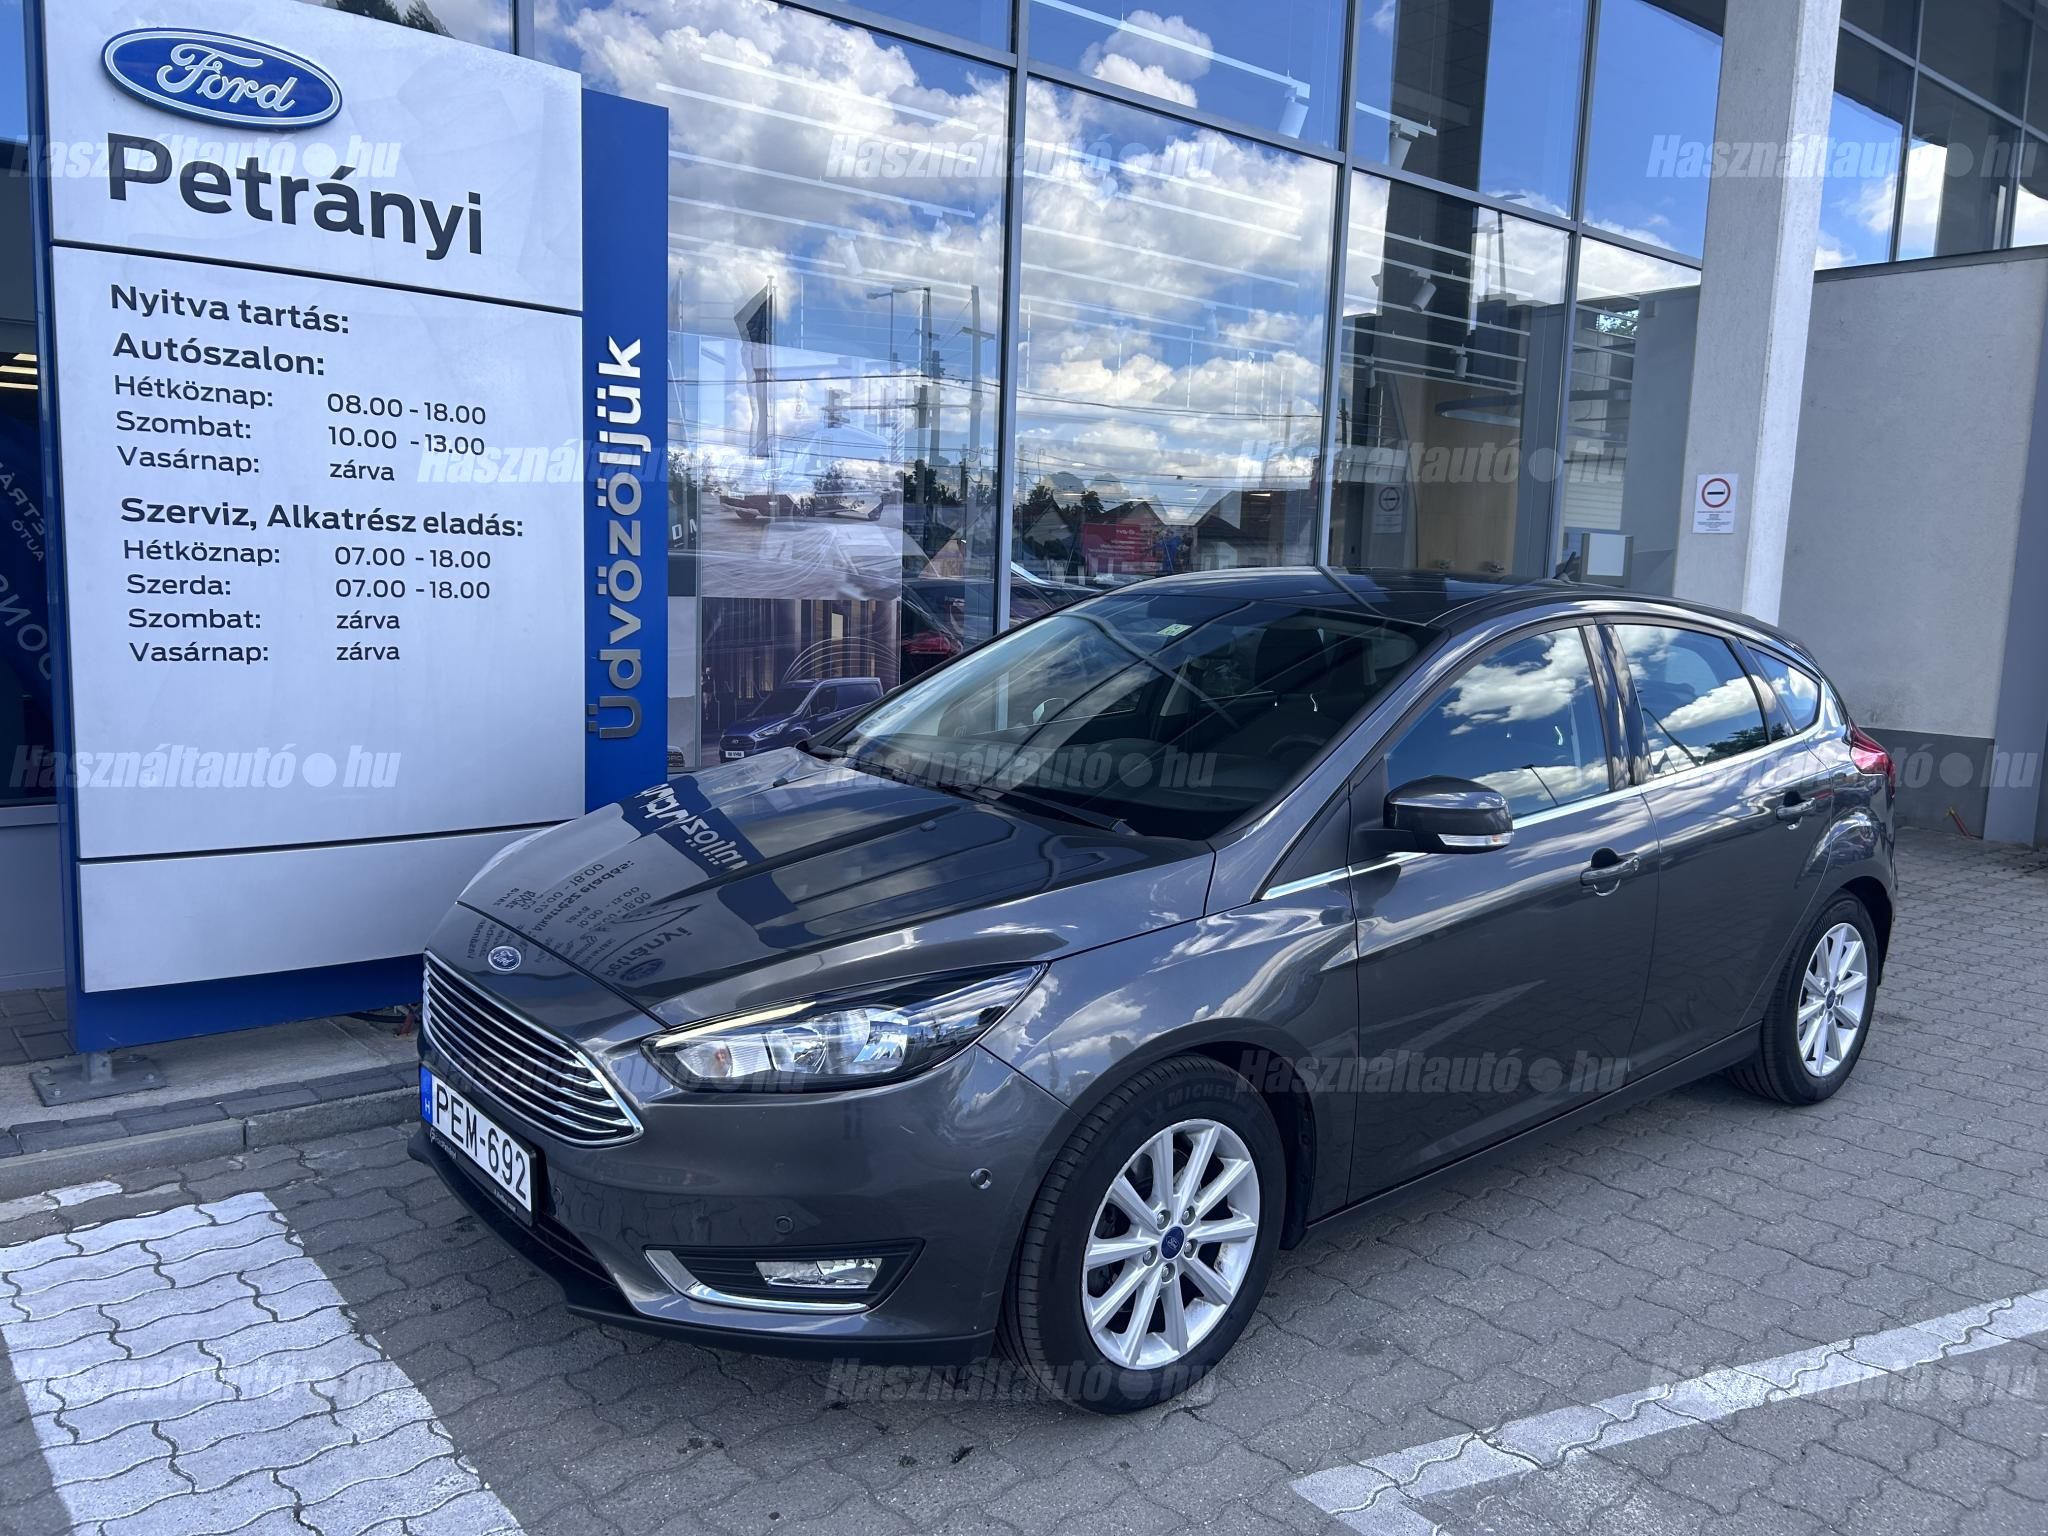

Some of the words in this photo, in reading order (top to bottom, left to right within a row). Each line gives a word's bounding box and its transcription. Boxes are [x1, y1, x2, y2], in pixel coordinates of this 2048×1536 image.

[157, 44, 297, 112] Ford
[108, 133, 481, 260] Petrányi
[111, 285, 229, 320] Nyitva
[238, 300, 348, 334] tartás:
[113, 333, 324, 375] Autószalon:
[115, 375, 272, 409] Hétköznap:
[328, 394, 402, 417] 08.00
[117, 411, 250, 438] Szombat:
[328, 426, 396, 449] 10.00
[117, 446, 259, 476] Vasárnap:
[330, 459, 394, 481] zárva
[121, 498, 256, 531] Szerviz,
[267, 505, 416, 532] Alkatrész
[423, 512, 522, 537] eladás:
[588, 335, 651, 738] Üdvözöljük
[124, 540, 279, 566] Hétköznap:
[335, 547, 404, 566] 07.00
[127, 574, 230, 595] Szerda:
[336, 579, 405, 598] 07.00
[129, 609, 260, 628] Szombat:
[337, 609, 400, 629] zárva
[129, 642, 268, 664] Vasárnap:
[337, 642, 400, 661] zárva
[436, 1083, 527, 1200] PEM-692
